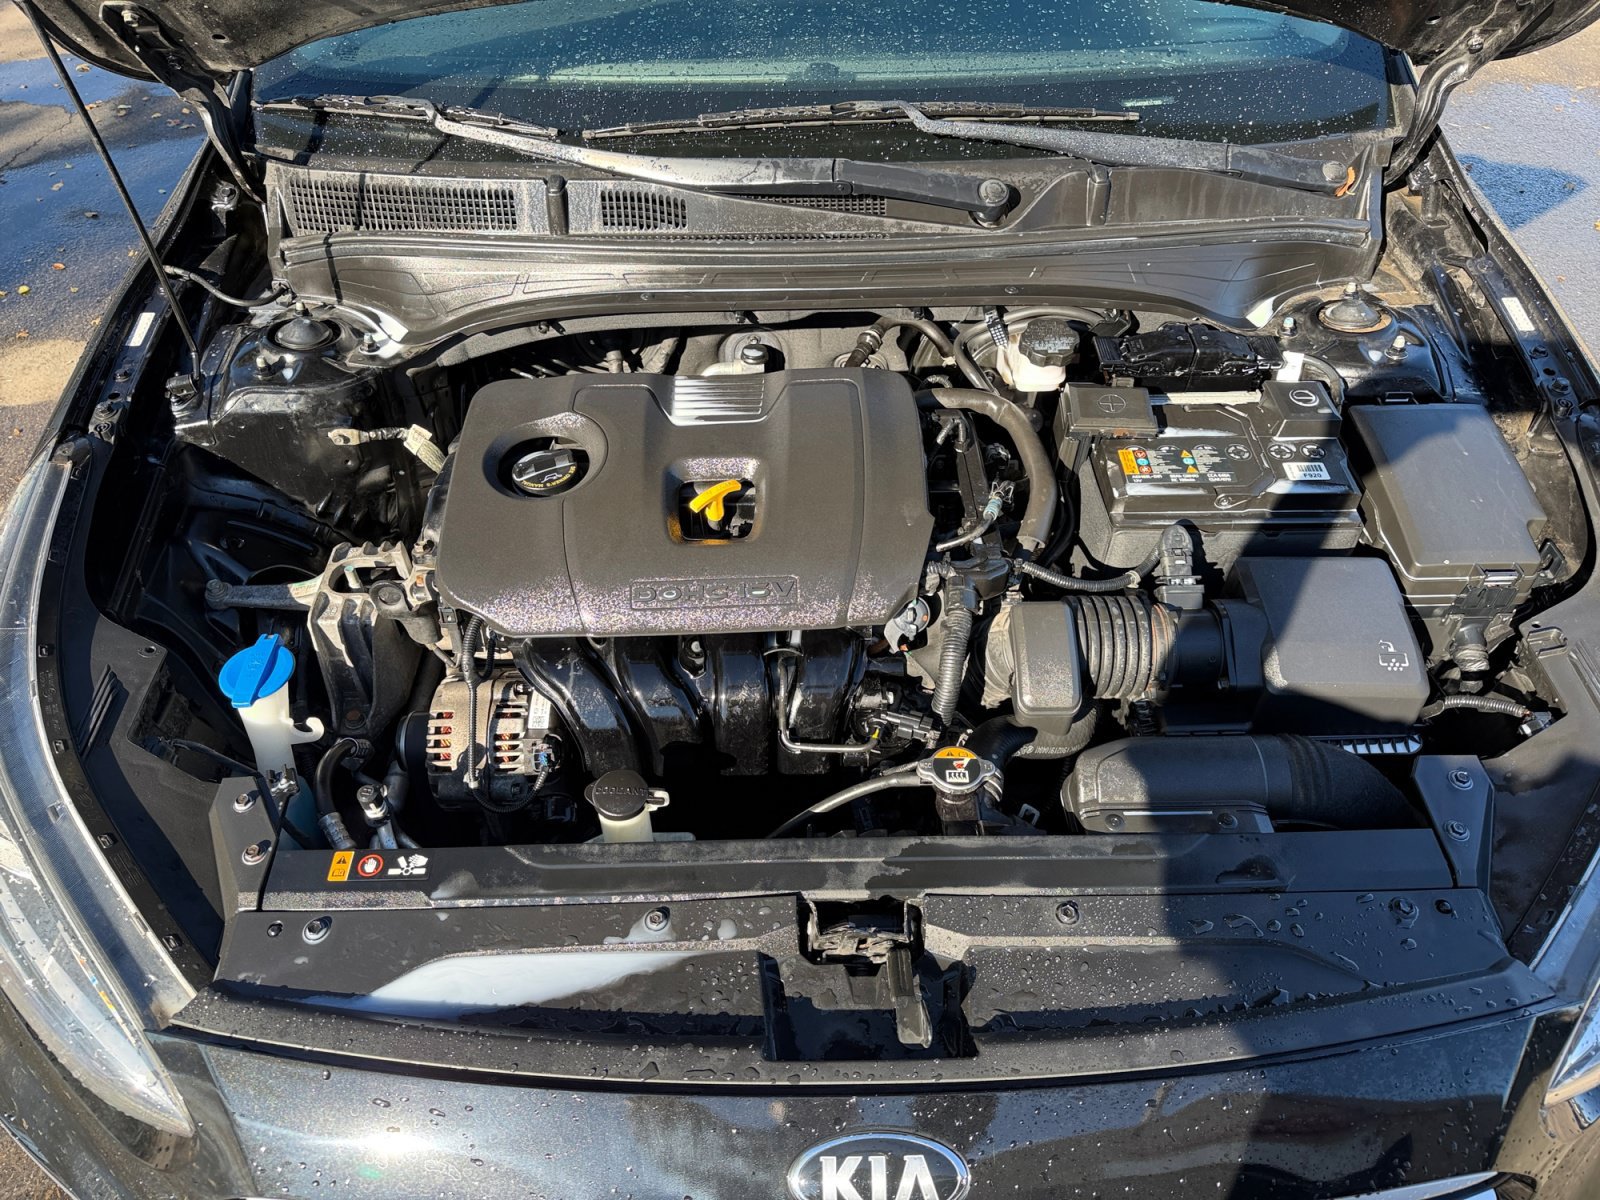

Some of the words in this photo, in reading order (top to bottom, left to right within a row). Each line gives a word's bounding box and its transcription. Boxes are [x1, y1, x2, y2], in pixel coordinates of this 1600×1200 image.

[521, 479, 544, 488] MANUAL
[632, 584, 730, 603] DOHC
[594, 786, 646, 797] COOLANT
[819, 1154, 940, 1200] KIA
